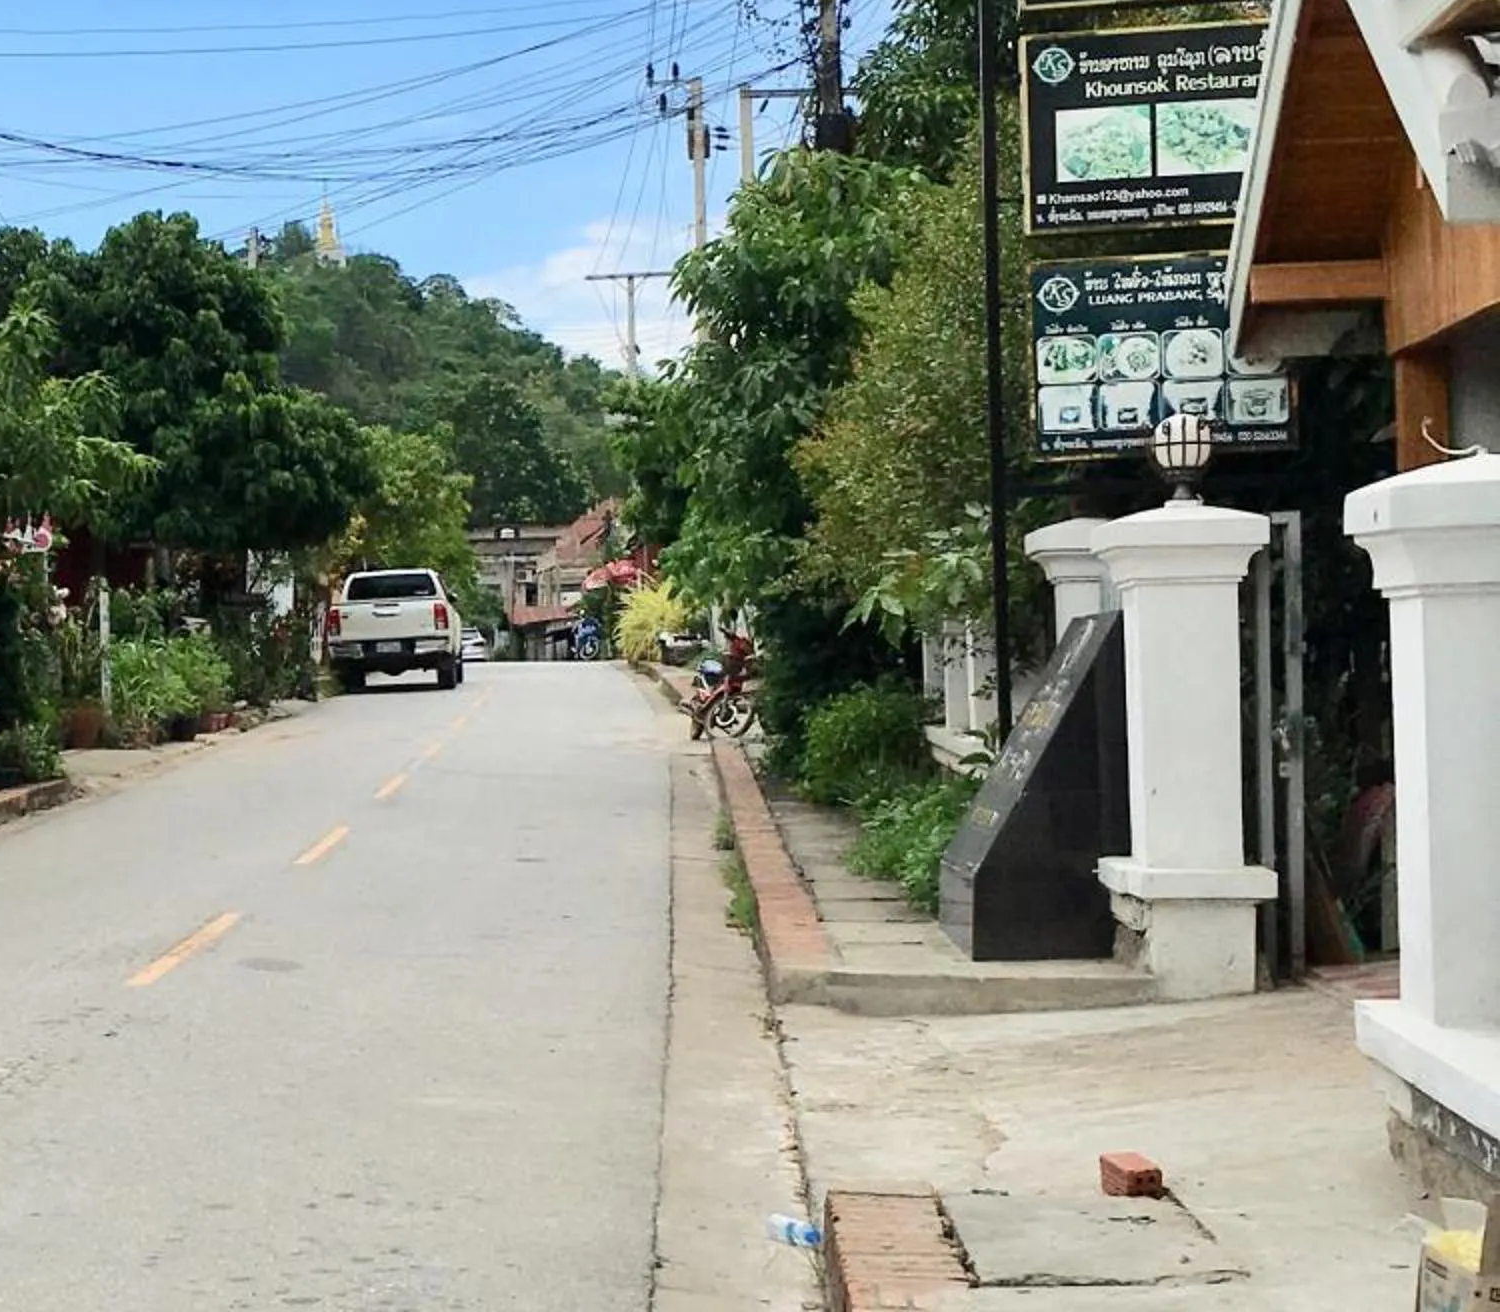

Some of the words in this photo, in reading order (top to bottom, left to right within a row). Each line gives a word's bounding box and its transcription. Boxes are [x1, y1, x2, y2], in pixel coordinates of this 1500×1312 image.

[1085, 75, 1170, 98] Khounsok
[1176, 71, 1262, 92] Restauran
[1088, 293, 1134, 305] LUANG
[1137, 289, 1203, 303] PRABANG
